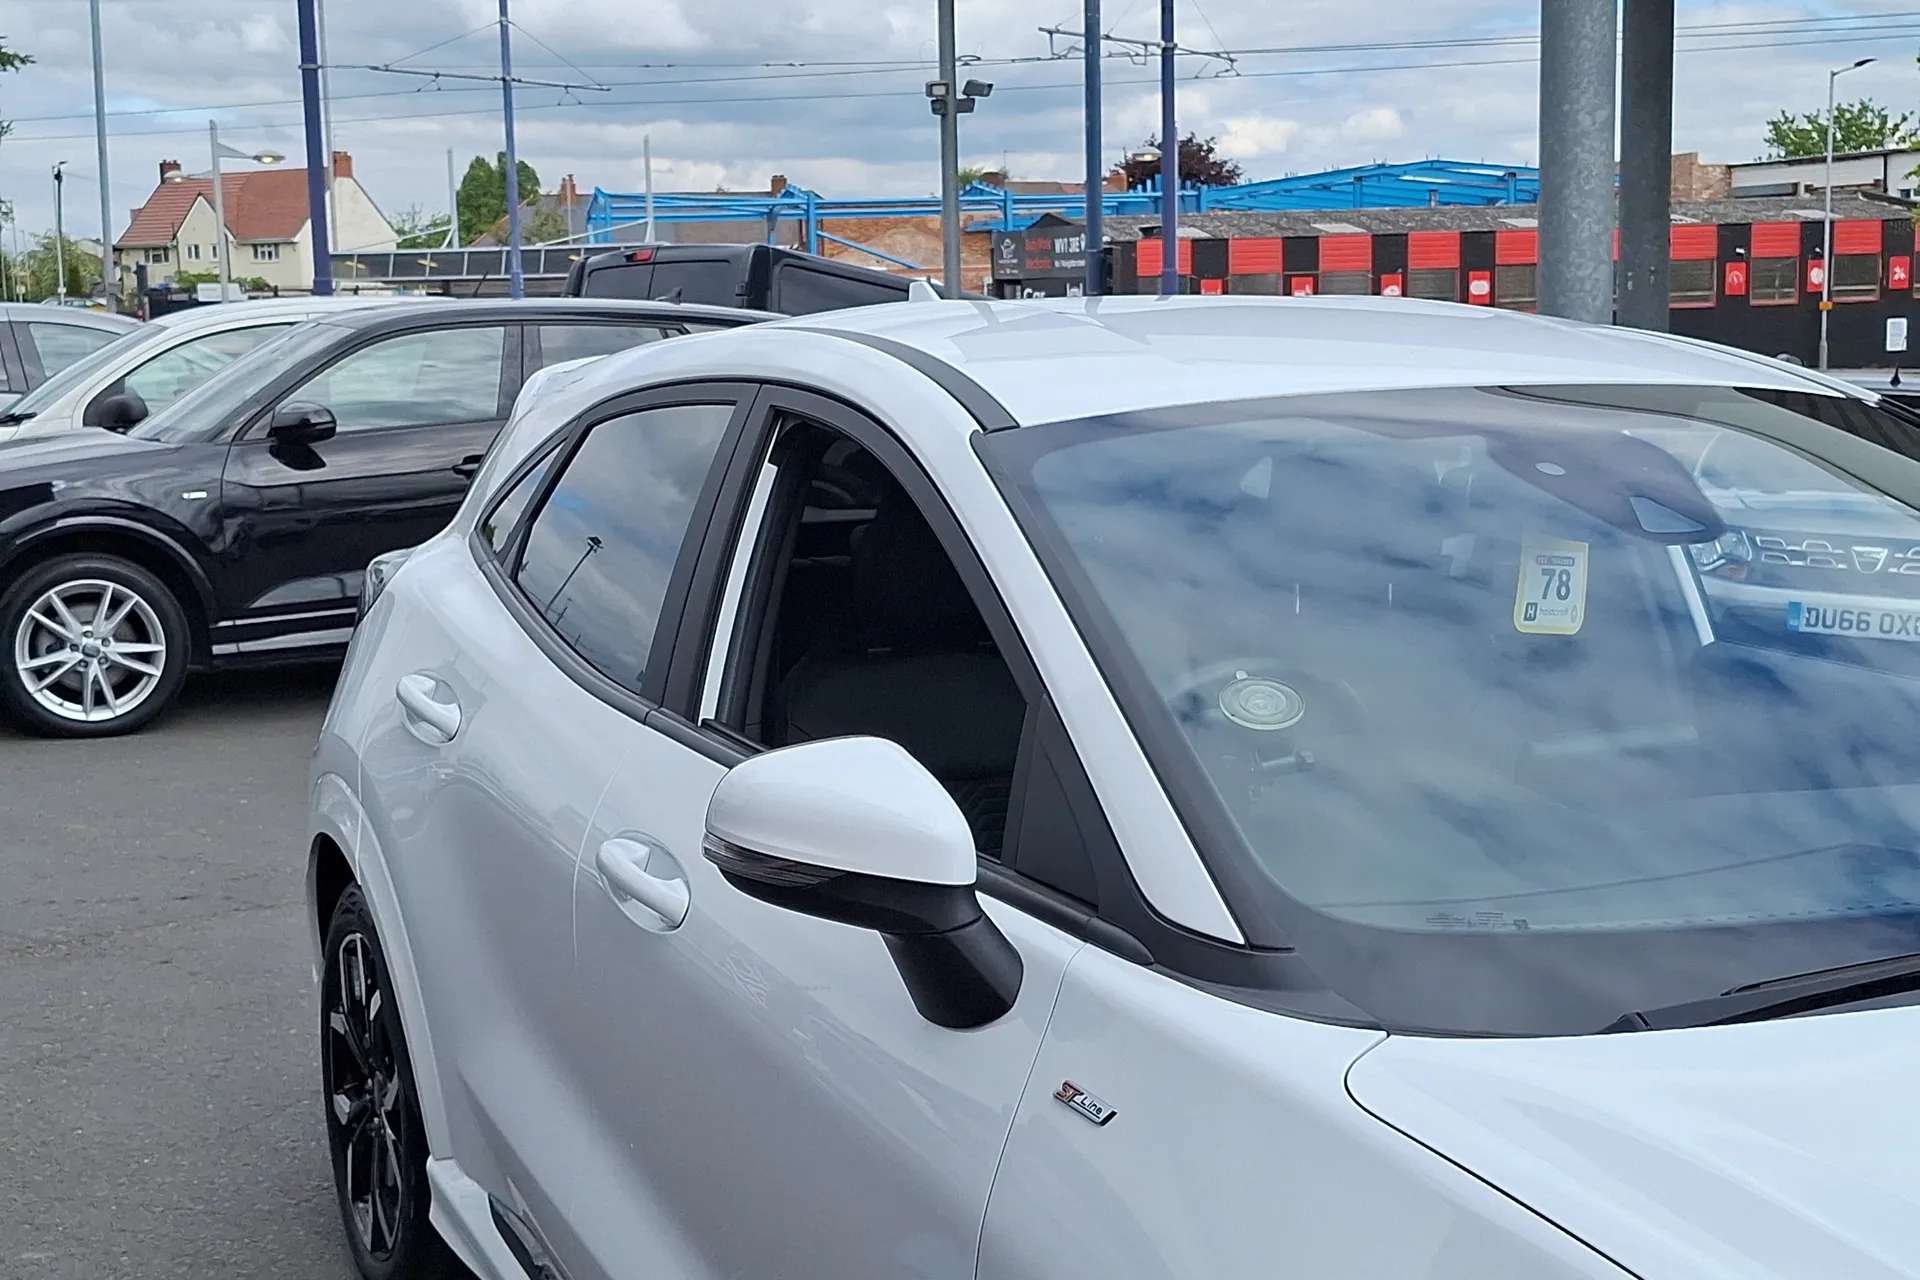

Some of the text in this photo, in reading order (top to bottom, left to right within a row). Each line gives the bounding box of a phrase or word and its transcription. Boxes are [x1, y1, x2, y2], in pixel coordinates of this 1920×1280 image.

[1541, 568, 1571, 601] 78
[1804, 606, 1872, 632] DU66
[1055, 1081, 1104, 1116] ST Line
